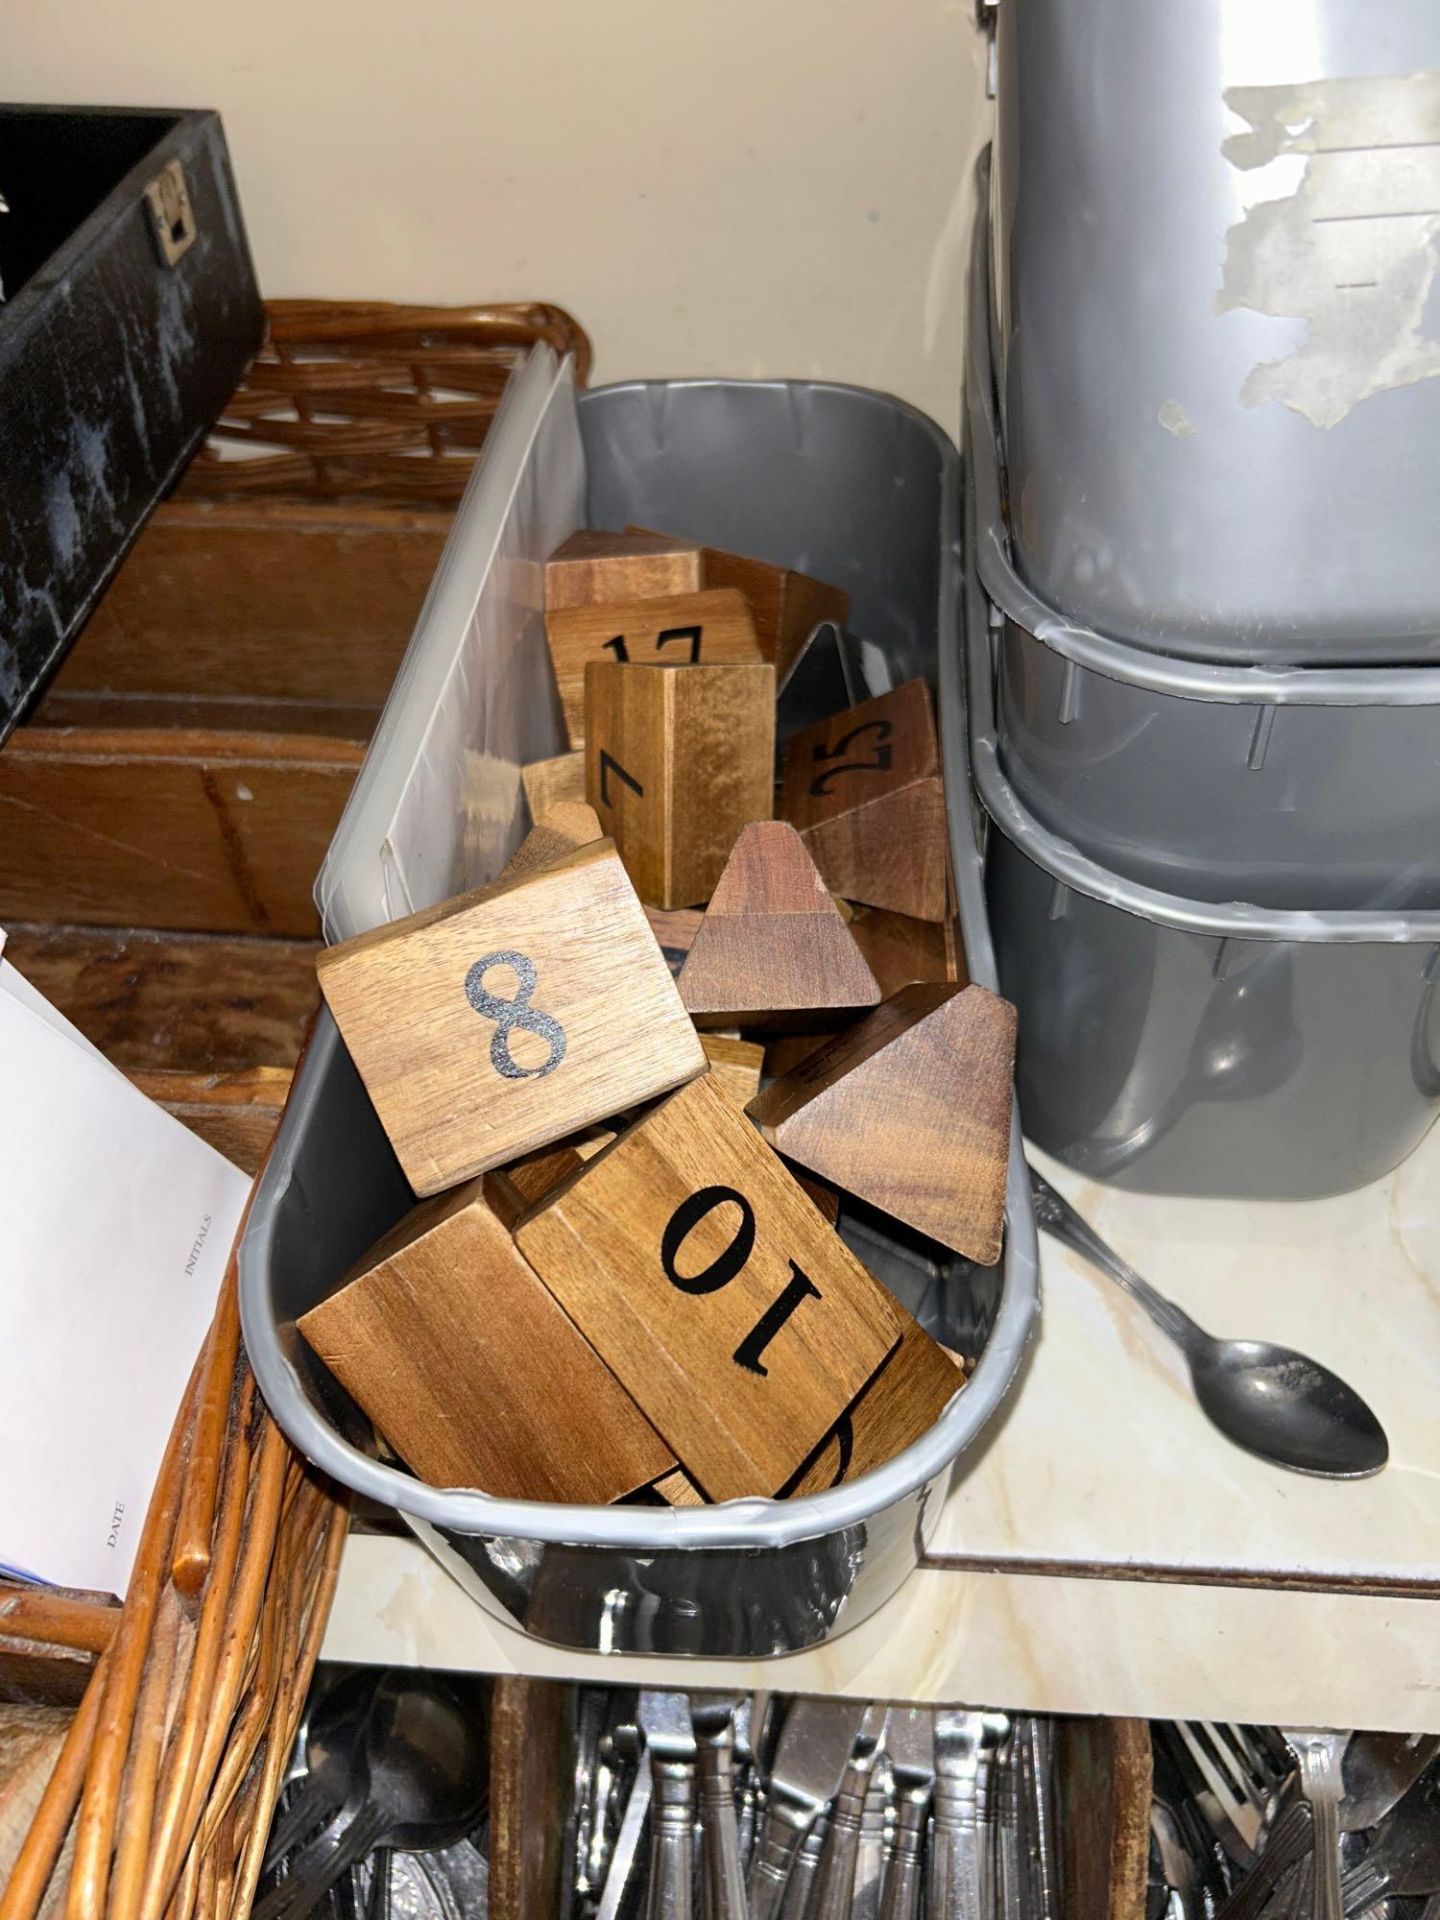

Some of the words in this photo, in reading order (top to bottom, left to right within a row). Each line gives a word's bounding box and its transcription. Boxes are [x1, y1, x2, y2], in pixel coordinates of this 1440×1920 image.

[600, 748, 644, 809] 7
[465, 950, 567, 1079] 8
[184, 1213, 212, 1277] INITIALS
[661, 1185, 822, 1376] 10
[107, 1501, 125, 1548] DATE
